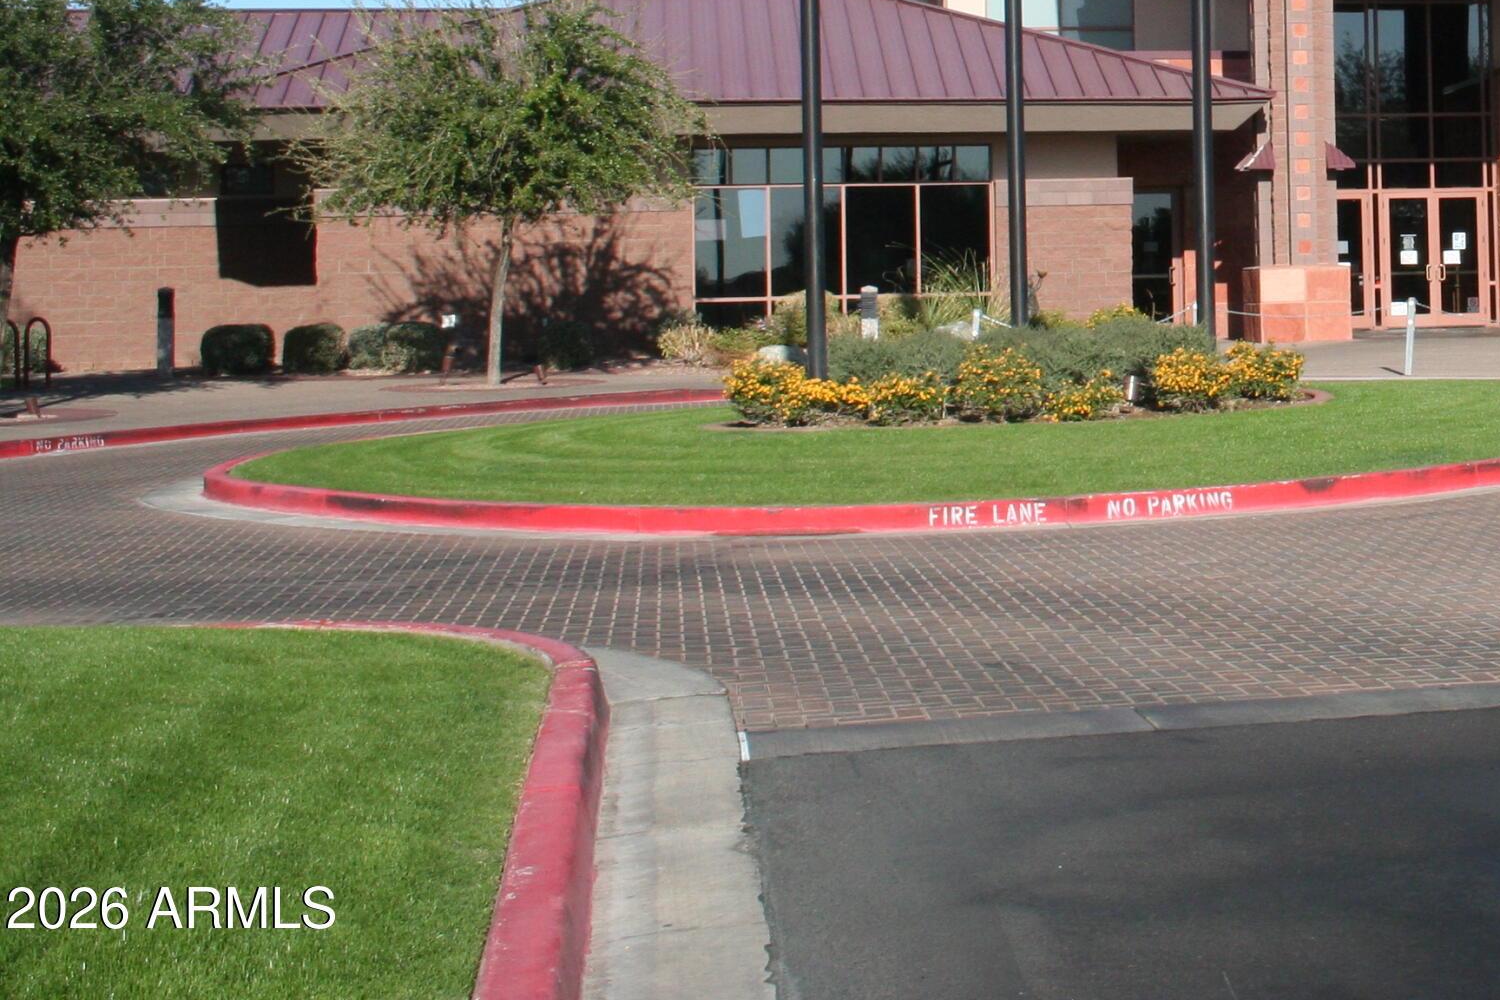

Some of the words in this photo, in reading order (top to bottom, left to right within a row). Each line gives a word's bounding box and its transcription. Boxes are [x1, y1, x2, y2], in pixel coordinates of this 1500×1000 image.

[36, 440, 52, 451] NO
[928, 505, 978, 527] FIRE
[992, 502, 1047, 525] LANE
[1106, 497, 1135, 519] NO
[1147, 491, 1233, 517] PARKING
